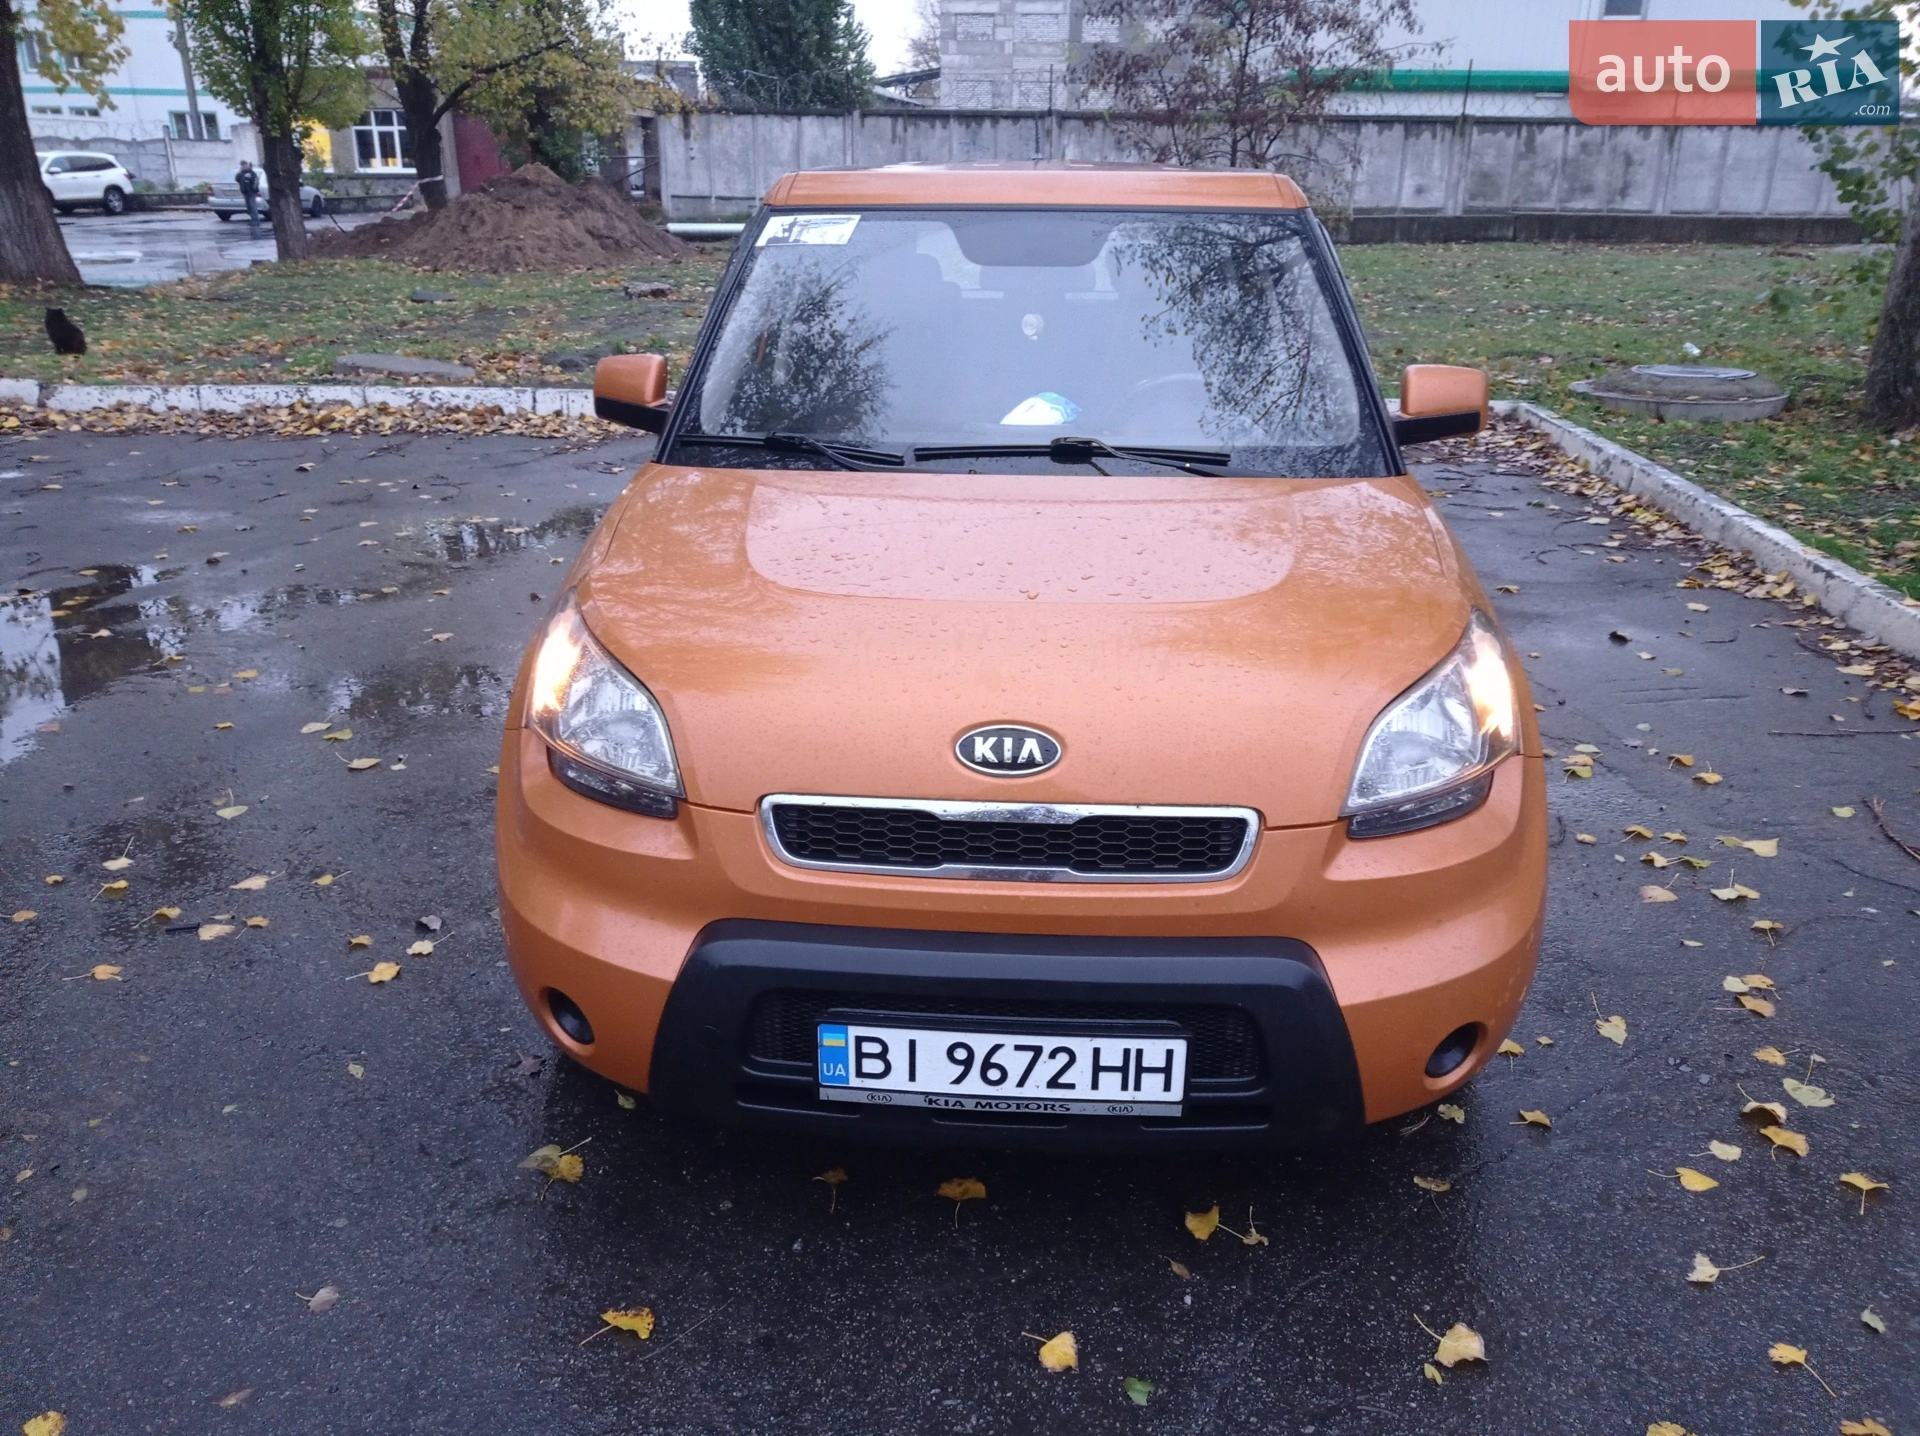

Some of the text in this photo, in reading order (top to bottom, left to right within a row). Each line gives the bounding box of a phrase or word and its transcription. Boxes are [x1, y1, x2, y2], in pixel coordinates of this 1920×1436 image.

[973, 736, 1044, 764] KIA
[823, 1063, 846, 1077] UA
[854, 1035, 1174, 1093] BI 9672 HH
[929, 1098, 1071, 1112] KIA MOTORS
